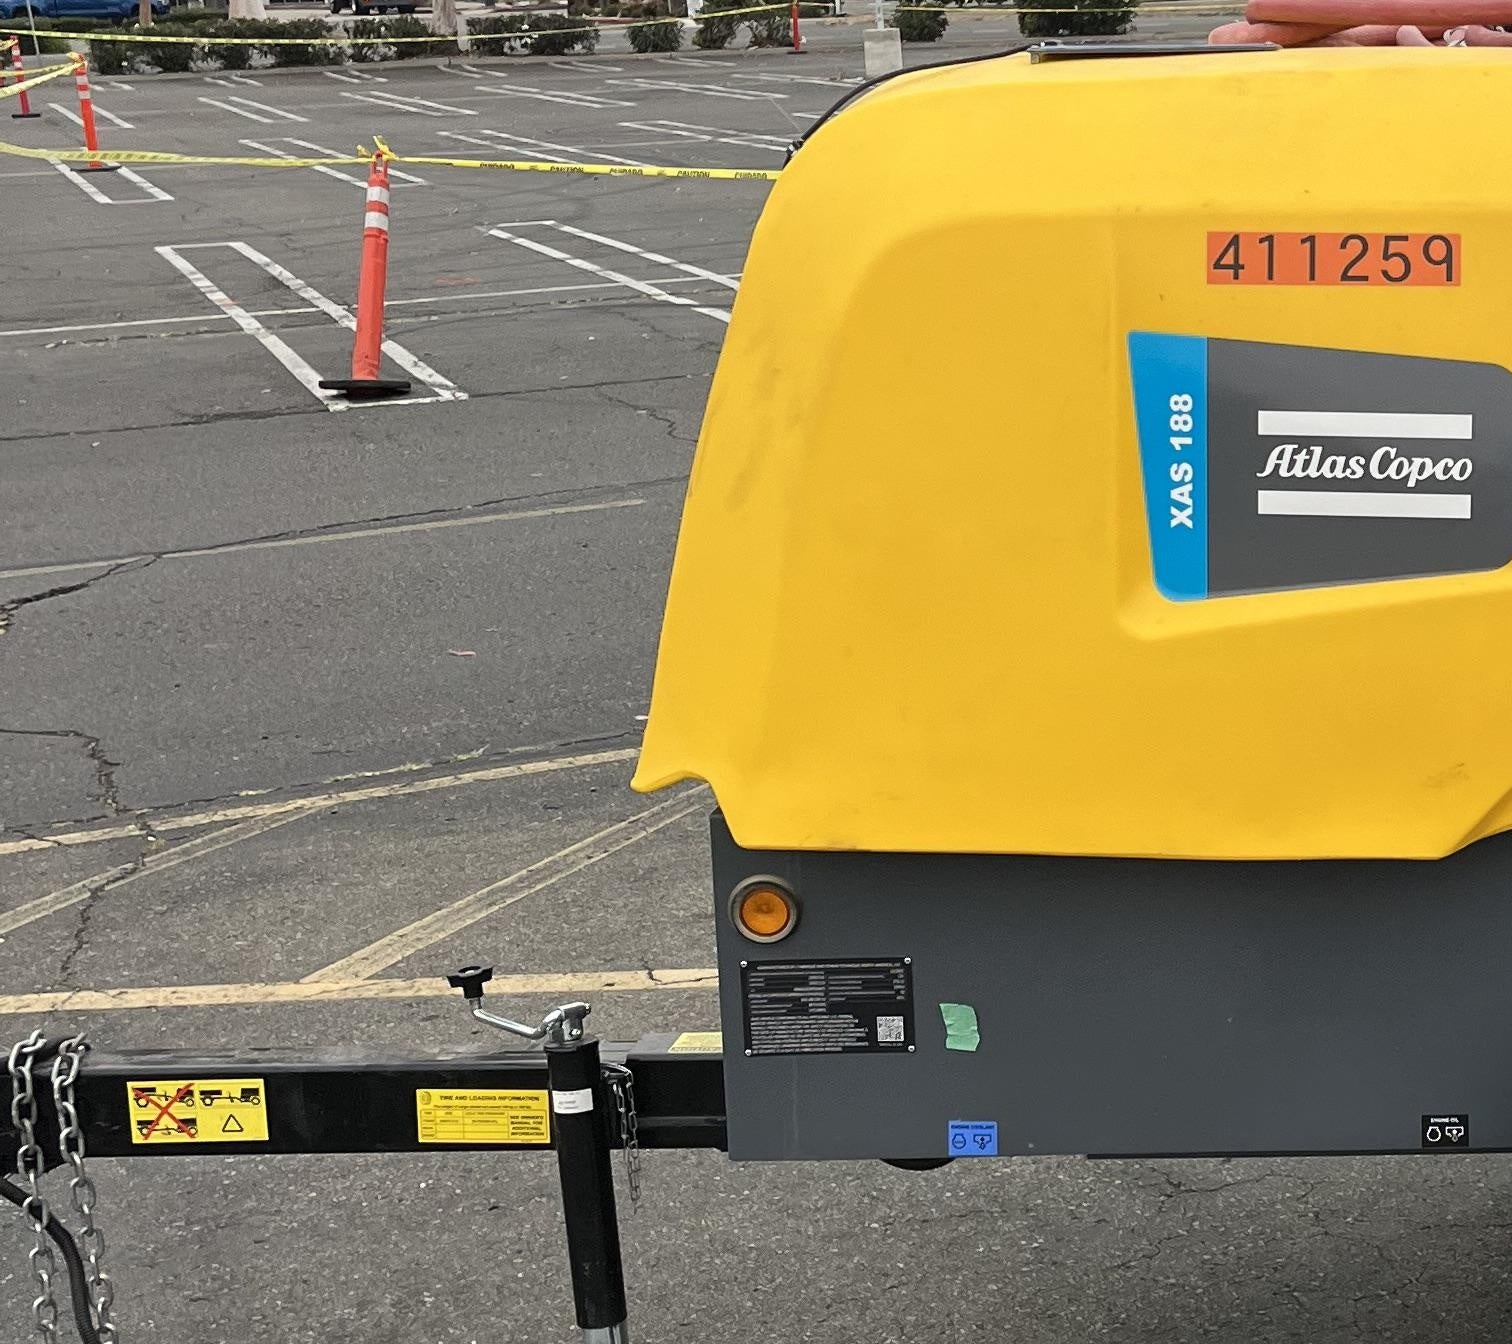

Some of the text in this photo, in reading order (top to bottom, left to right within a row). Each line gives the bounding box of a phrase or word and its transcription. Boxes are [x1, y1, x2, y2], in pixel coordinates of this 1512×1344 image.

[1210, 232, 1455, 282] 411259
[1169, 392, 1195, 529] XAS 188
[1256, 443, 1473, 488] Atlas Copco
